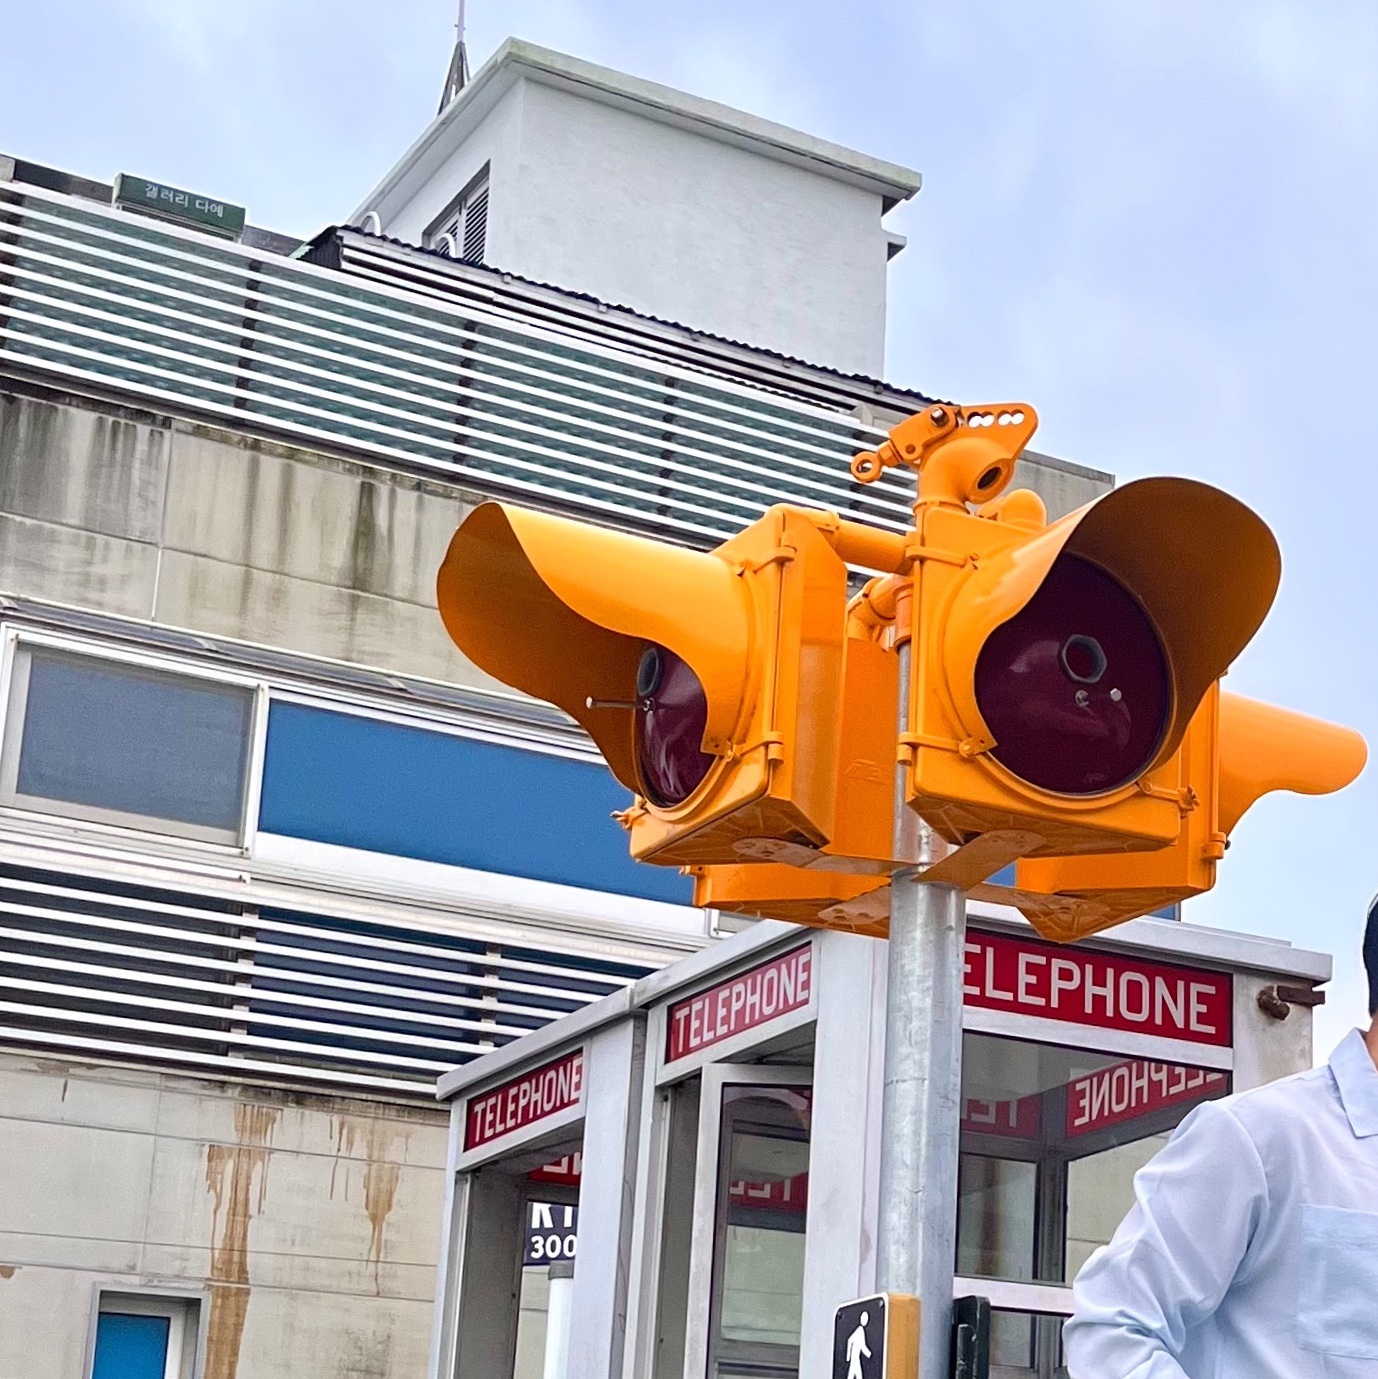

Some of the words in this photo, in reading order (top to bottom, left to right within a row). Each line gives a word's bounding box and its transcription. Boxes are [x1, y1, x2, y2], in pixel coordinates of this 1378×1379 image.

[145, 183, 190, 208] 갤러리
[675, 951, 812, 1053] TELEPHONE
[962, 943, 1217, 1035] ELEPHONE
[473, 1053, 584, 1143] TELEPHONE
